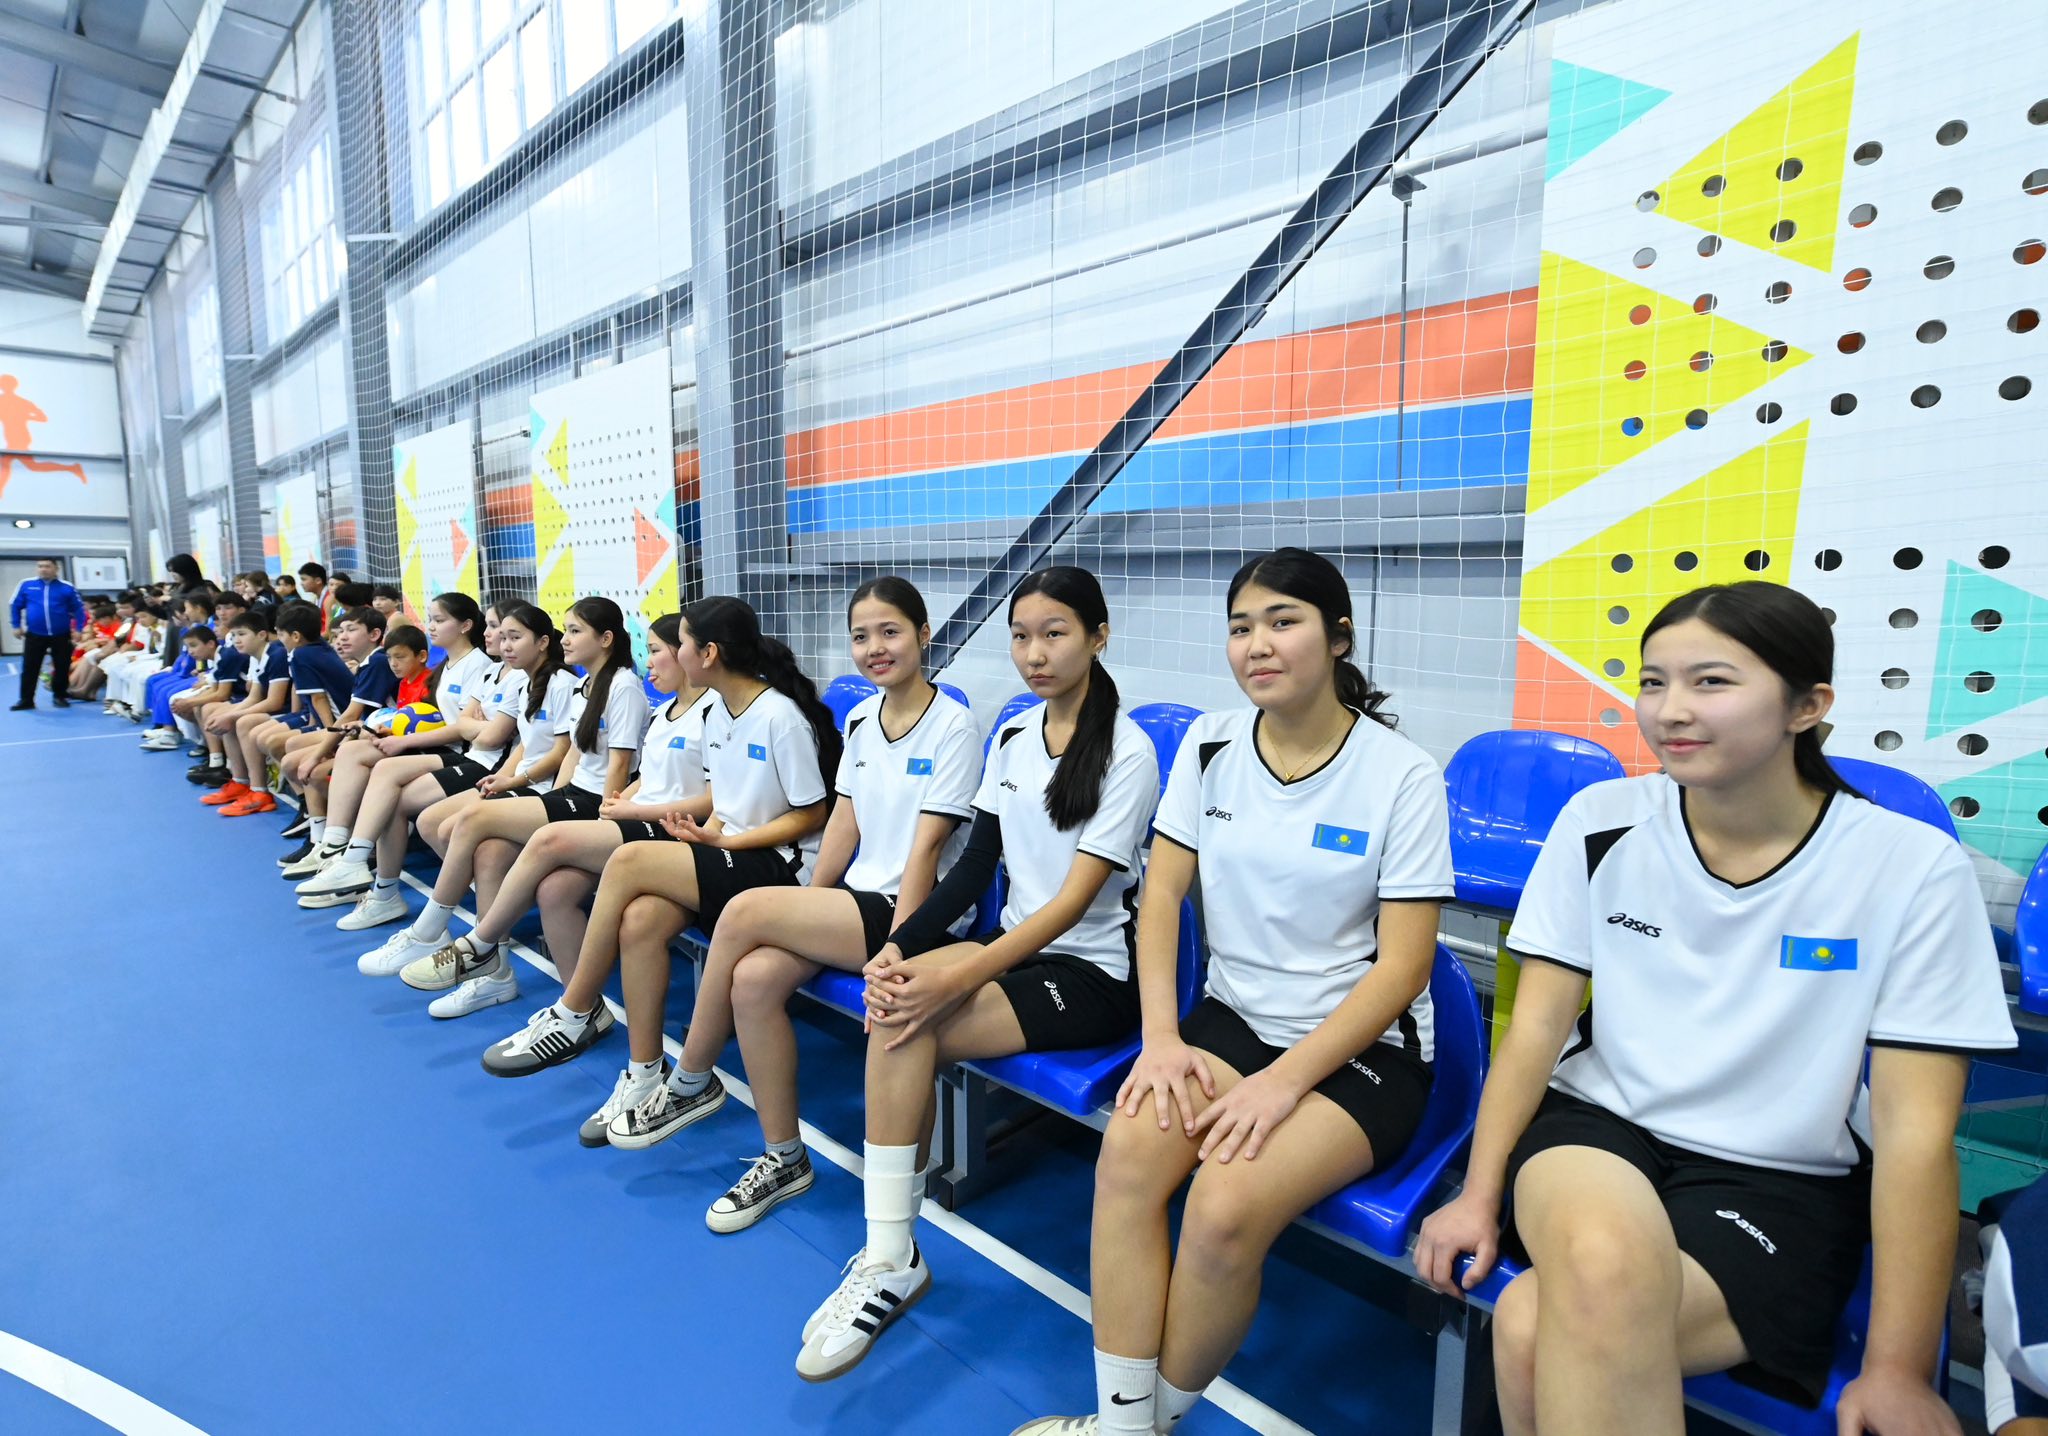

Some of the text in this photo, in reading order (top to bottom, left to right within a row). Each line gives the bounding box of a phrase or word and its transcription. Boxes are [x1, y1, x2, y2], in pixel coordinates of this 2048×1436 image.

[1215, 809, 1233, 822] asics
[1622, 917, 1662, 938] asics
[1050, 988, 1066, 1012] asics
[1352, 1061, 1382, 1085] asics
[1735, 1218, 1777, 1254] asics
